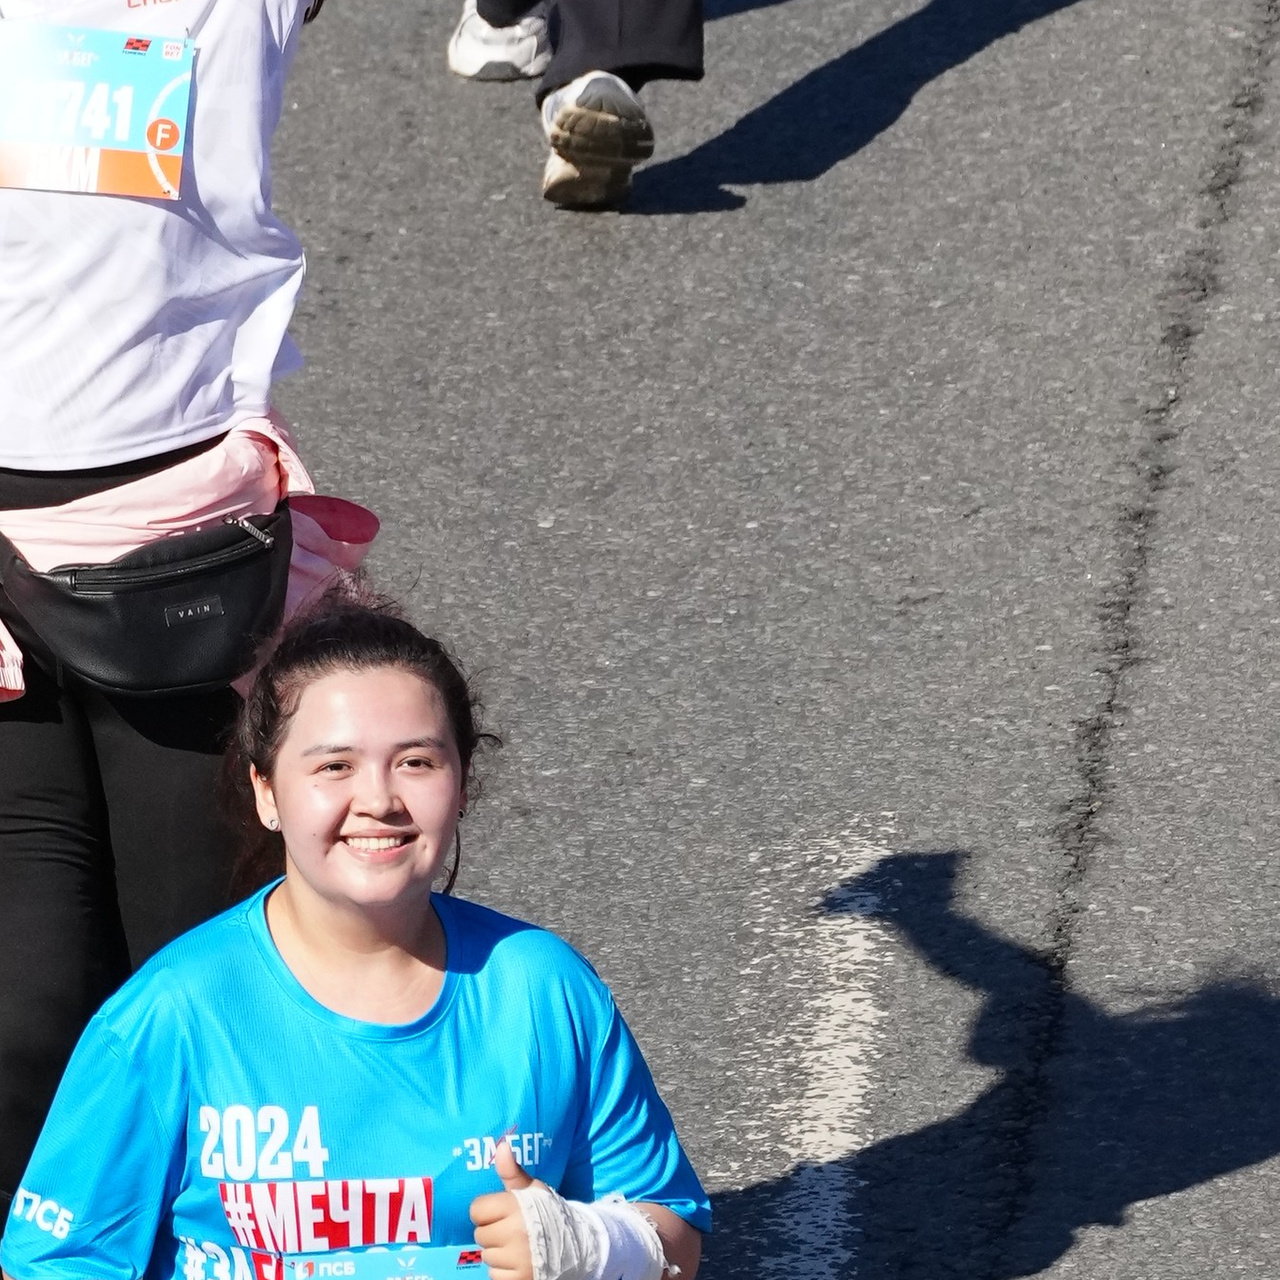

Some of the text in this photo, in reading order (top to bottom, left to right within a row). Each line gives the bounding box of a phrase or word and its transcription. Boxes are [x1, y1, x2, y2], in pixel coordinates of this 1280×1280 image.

[20, 80, 134, 142] 741
[156, 123, 172, 147] F
[178, 604, 210, 618] VAIN
[199, 1104, 329, 1181] 2024
[13, 1187, 74, 1240] ПСБ
[224, 1177, 432, 1254] #МЕЧТА
[320, 1261, 356, 1277] ПСБ
